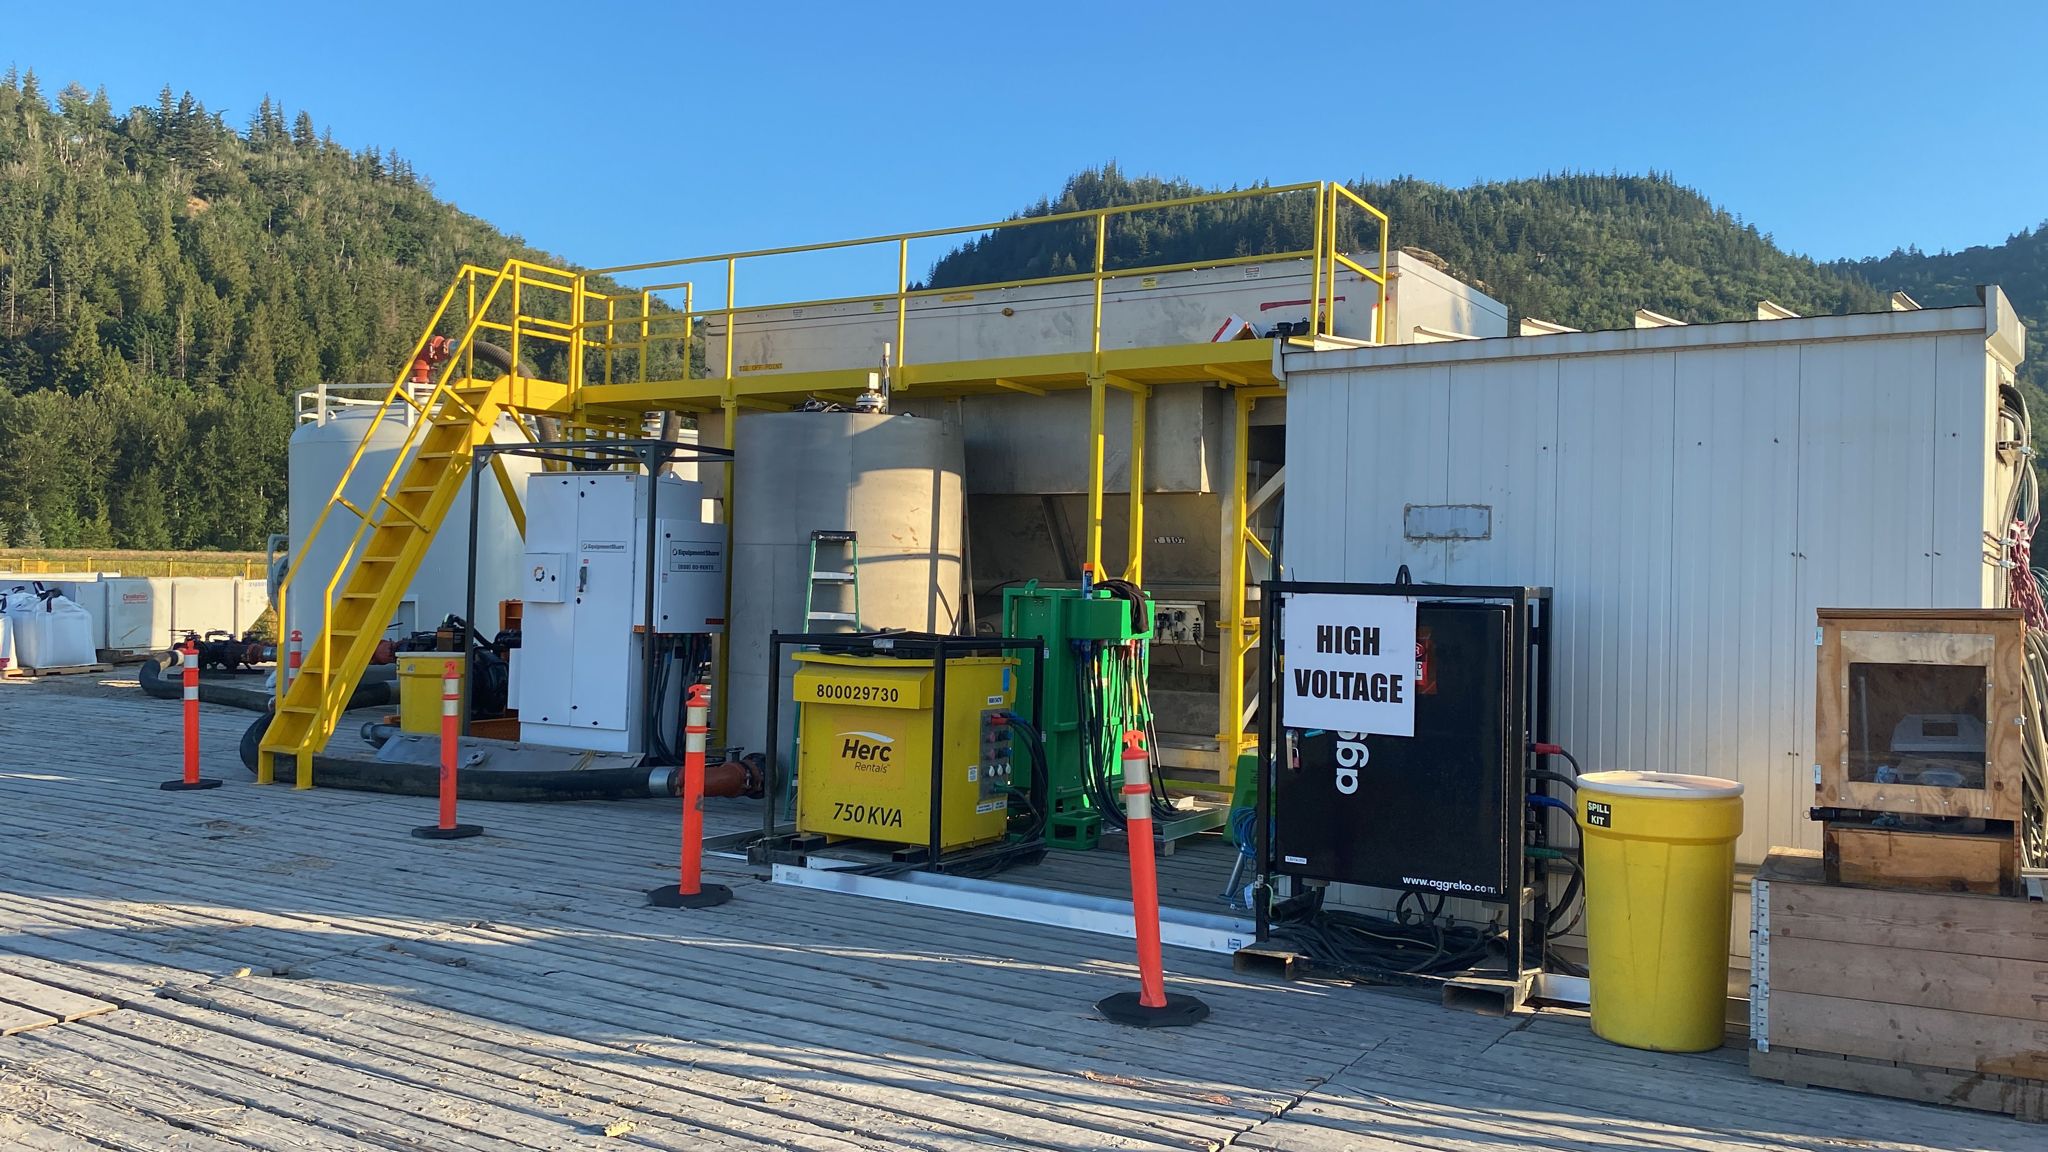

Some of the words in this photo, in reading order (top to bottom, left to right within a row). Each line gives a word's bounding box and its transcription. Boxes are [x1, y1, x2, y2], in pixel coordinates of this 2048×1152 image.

[678, 548, 720, 558] EquipmentShare
[1316, 625, 1380, 656] HIGH
[816, 683, 899, 703] 800029730
[1294, 668, 1403, 704] VOLTAGE
[841, 738, 892, 762] Herc
[833, 802, 865, 823] 750
[867, 805, 903, 828] KVA
[1587, 801, 1610, 815] SPILL
[1591, 814, 1605, 826] KIT
[1402, 876, 1497, 894] www.aggreko.com
